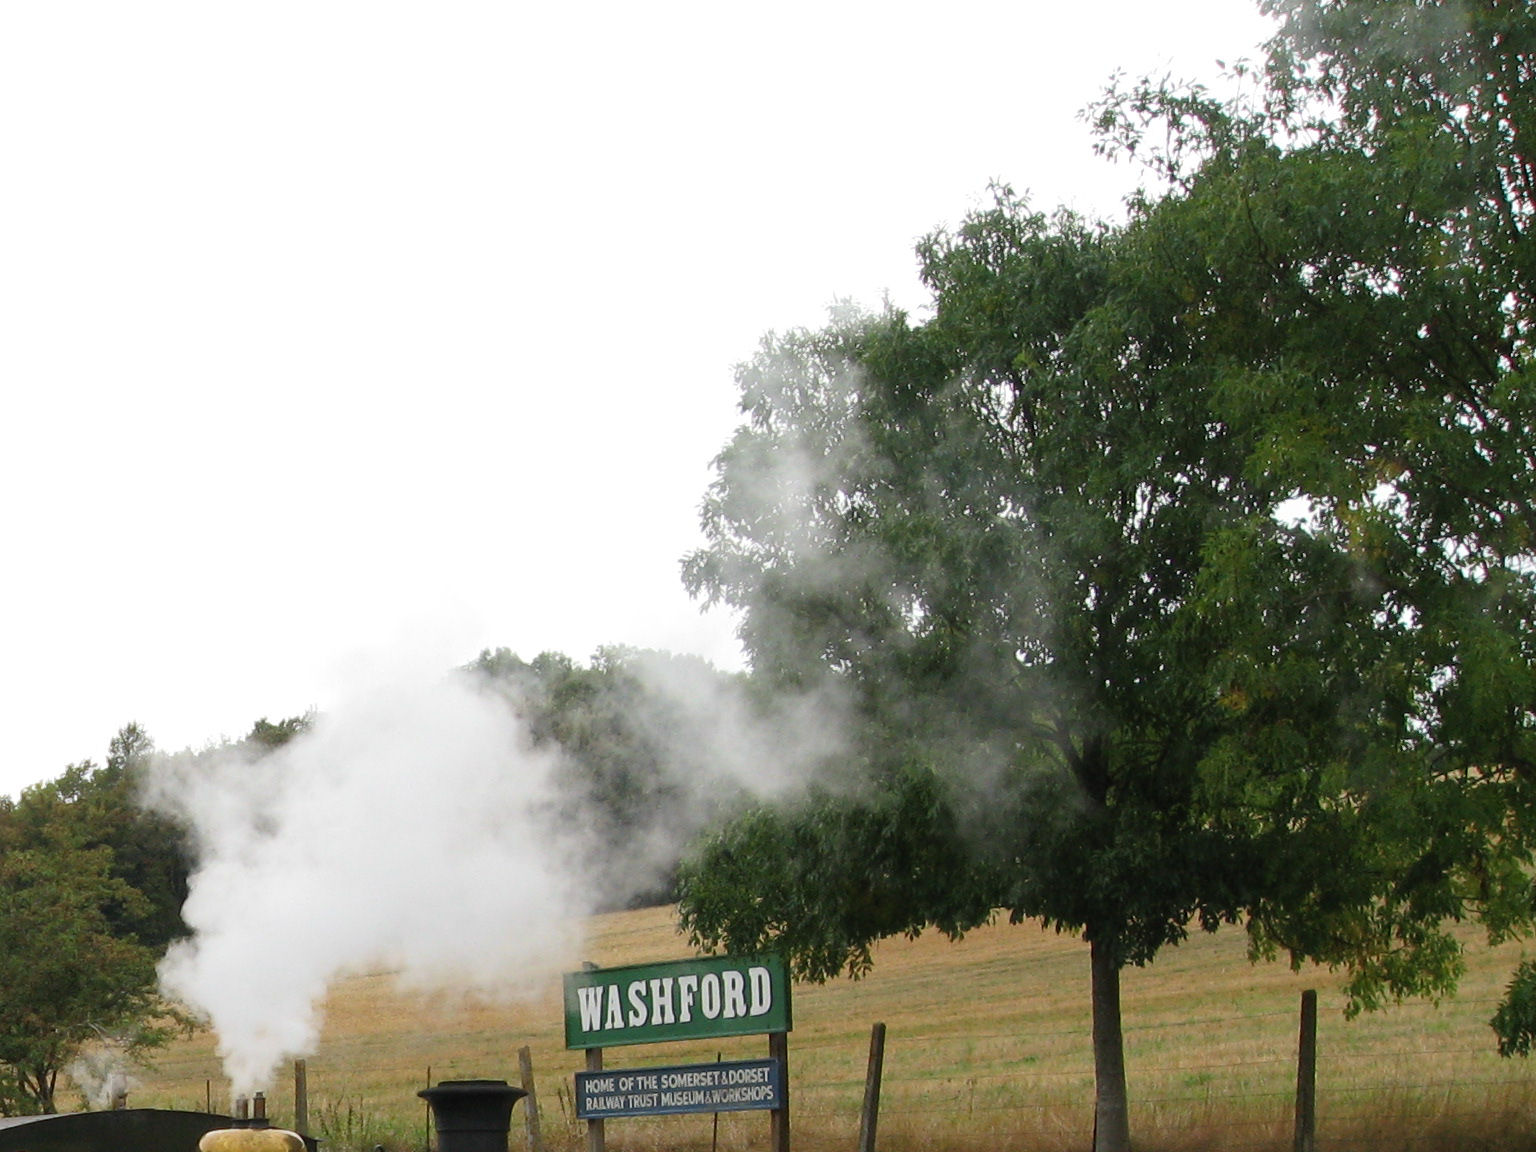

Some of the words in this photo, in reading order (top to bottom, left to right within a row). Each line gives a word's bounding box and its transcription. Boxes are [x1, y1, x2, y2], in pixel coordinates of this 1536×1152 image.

[577, 966, 772, 1033] WASHFORD
[585, 1079, 614, 1094] HOME
[619, 1077, 634, 1090] OF
[636, 1075, 658, 1090] THE
[661, 1070, 720, 1089] SOMERSET
[729, 1067, 770, 1084] DORSET
[586, 1096, 625, 1111] RAILWAY
[628, 1094, 658, 1109] TRUST
[661, 1090, 705, 1107] MUSEUM
[712, 1085, 774, 1103] WORKSHOPS
